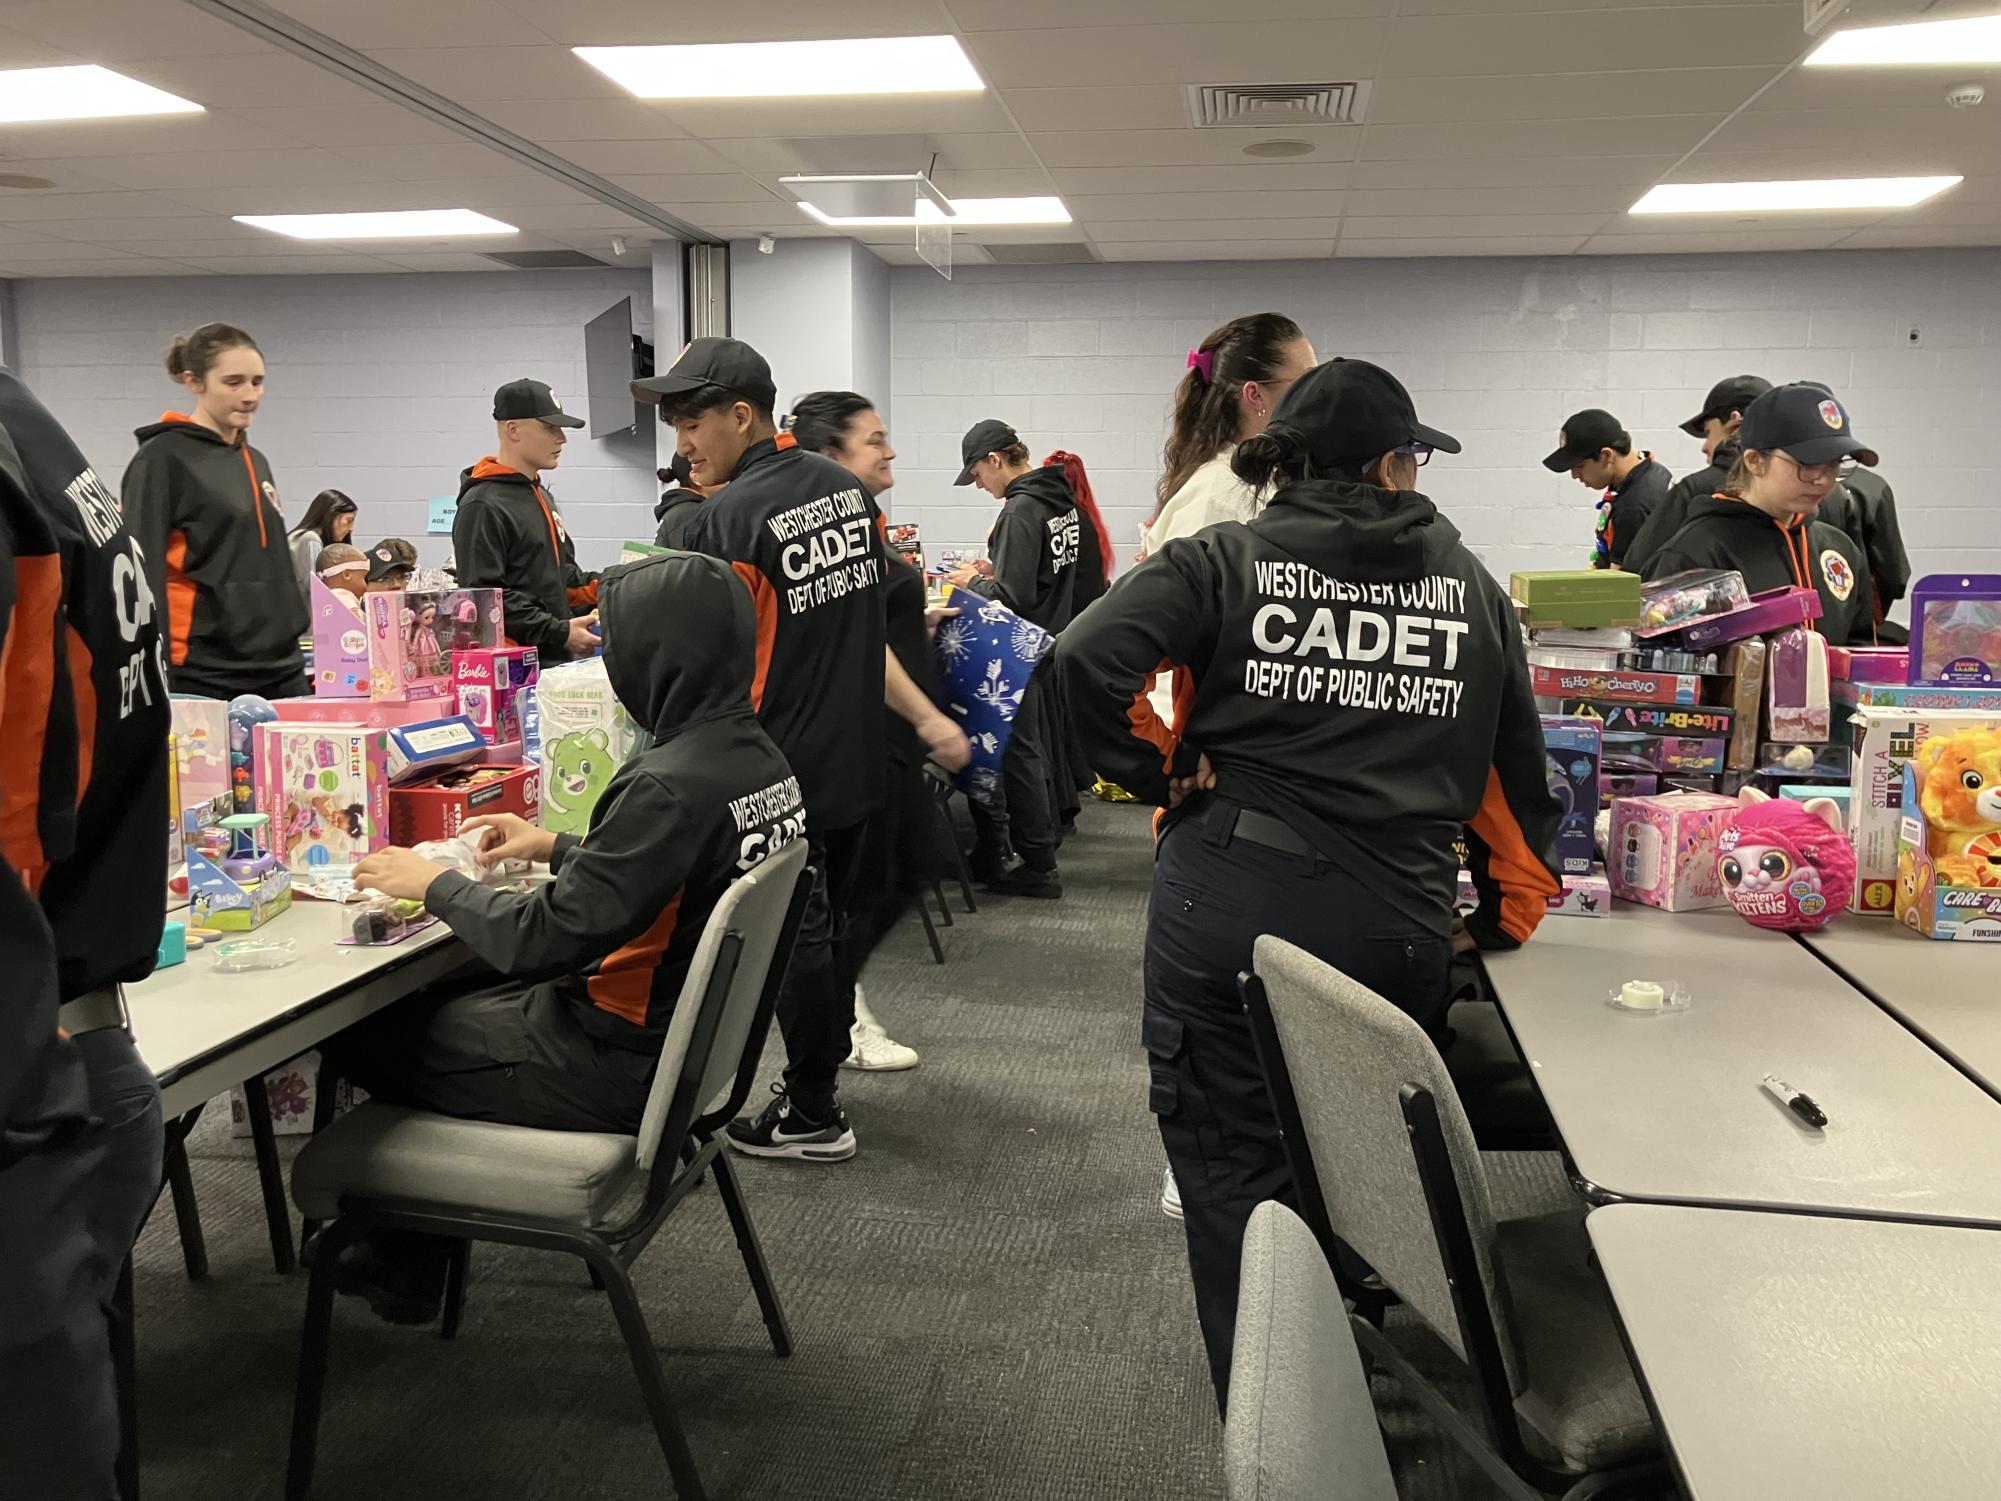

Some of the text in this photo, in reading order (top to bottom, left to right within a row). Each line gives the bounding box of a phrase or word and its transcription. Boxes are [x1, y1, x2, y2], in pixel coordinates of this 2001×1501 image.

[767, 488, 866, 543] WESTCHESTER COUNTY
[782, 518, 871, 581] CADET
[1255, 560, 1466, 614] WESTCHESTER COUNTY
[1252, 603, 1469, 671] CADET
[457, 661, 491, 680] Barbie
[1244, 659, 1464, 718] DEPT OF PUBLIC SAFETY
[351, 737, 361, 778] battat
[1872, 750, 1889, 809] STITCH A
[1731, 900, 1787, 916] KITTENS
[1734, 891, 1774, 902] Smitten
[1943, 891, 1988, 906] CARE
